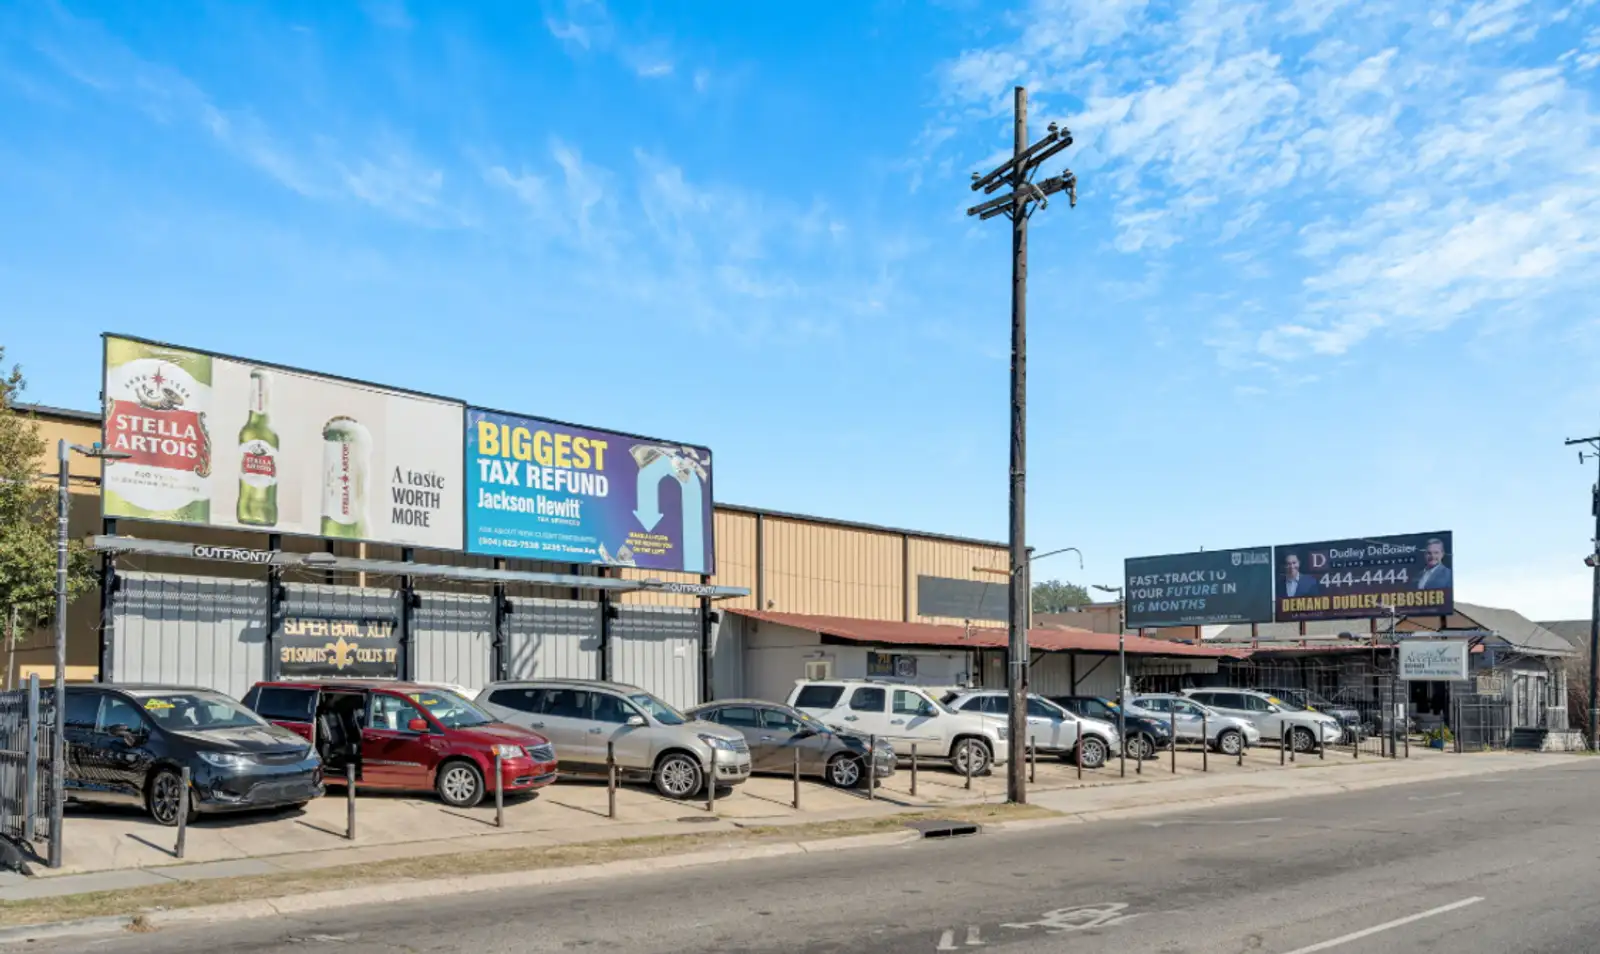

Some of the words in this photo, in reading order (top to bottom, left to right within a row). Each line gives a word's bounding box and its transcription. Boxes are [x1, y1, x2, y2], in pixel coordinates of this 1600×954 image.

[116, 414, 197, 440] STELLA
[115, 433, 197, 458] ARTOIS
[478, 420, 608, 470] BIGGEST
[392, 465, 403, 484] A
[407, 469, 445, 489] taste
[477, 458, 520, 486] TAX
[526, 463, 608, 497] REFUND
[392, 486, 440, 509] WORTH
[478, 487, 535, 514] Jackson
[537, 494, 581, 518] Hewitt
[392, 507, 430, 527] MORE
[1330, 548, 1365, 561] Dudley
[1130, 570, 1205, 586] FAST-TRACK
[1319, 567, 1409, 588] 444-4444
[1130, 587, 1164, 599] YOUR
[1166, 584, 1219, 597] FUTURE
[1222, 582, 1237, 594] IN
[1282, 595, 1330, 612] DEMAND
[1333, 593, 1379, 610] DUDLEY
[1381, 590, 1445, 607] DEBOSIER
[1148, 599, 1206, 612] MONTHS
[284, 618, 328, 636] SUPER
[331, 620, 363, 637] BOWL
